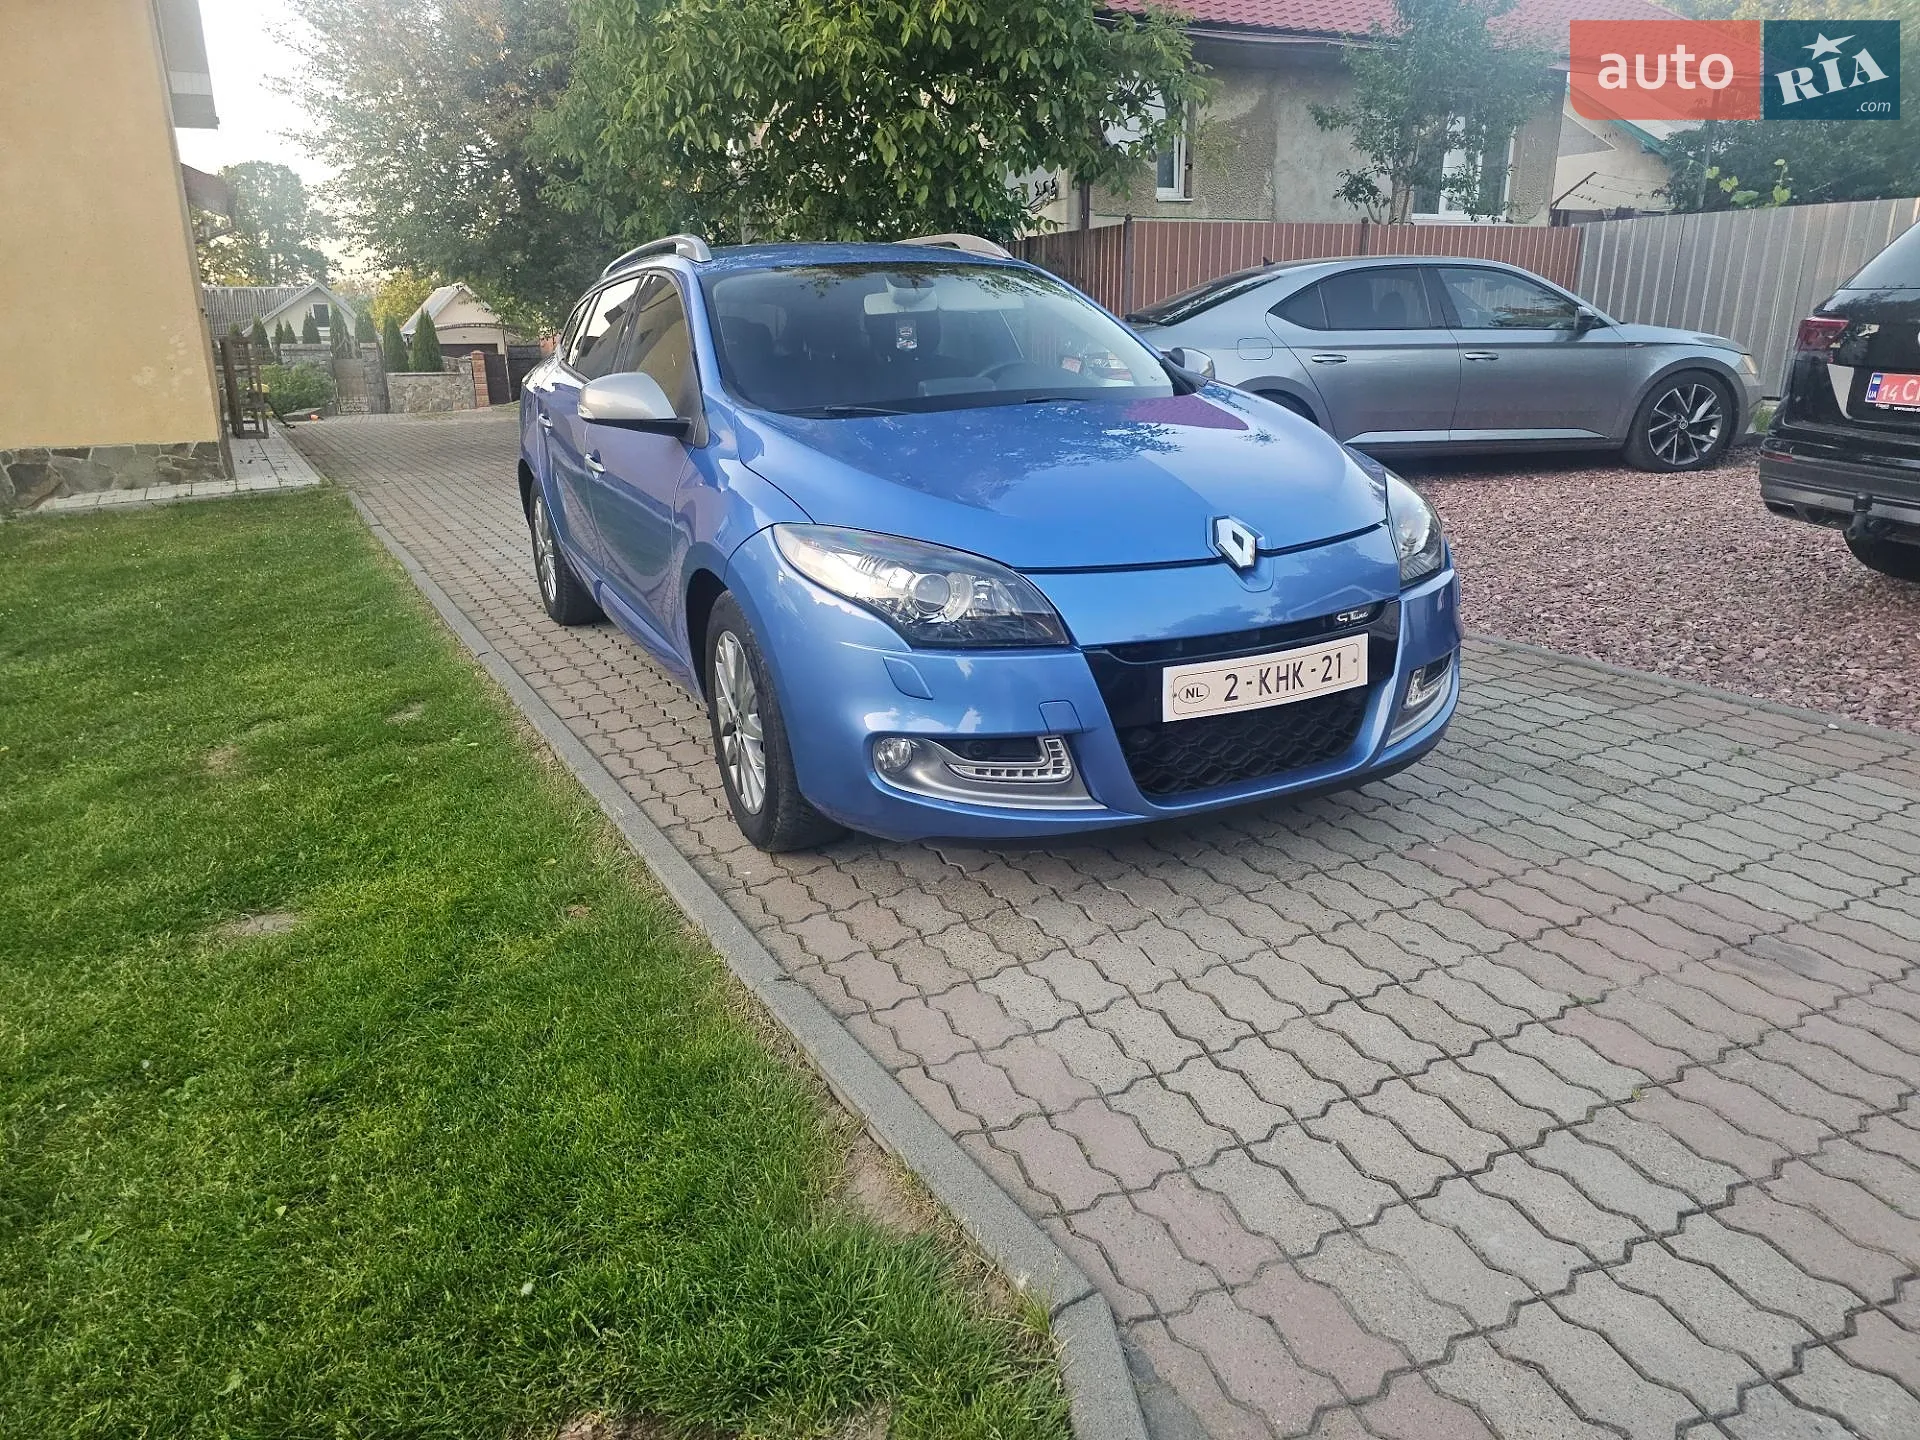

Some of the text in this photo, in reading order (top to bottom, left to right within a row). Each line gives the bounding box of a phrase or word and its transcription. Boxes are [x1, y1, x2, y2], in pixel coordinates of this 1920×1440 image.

[1868, 390, 1877, 398] UA
[1881, 385, 1899, 401] 14
[1185, 687, 1205, 699] NL
